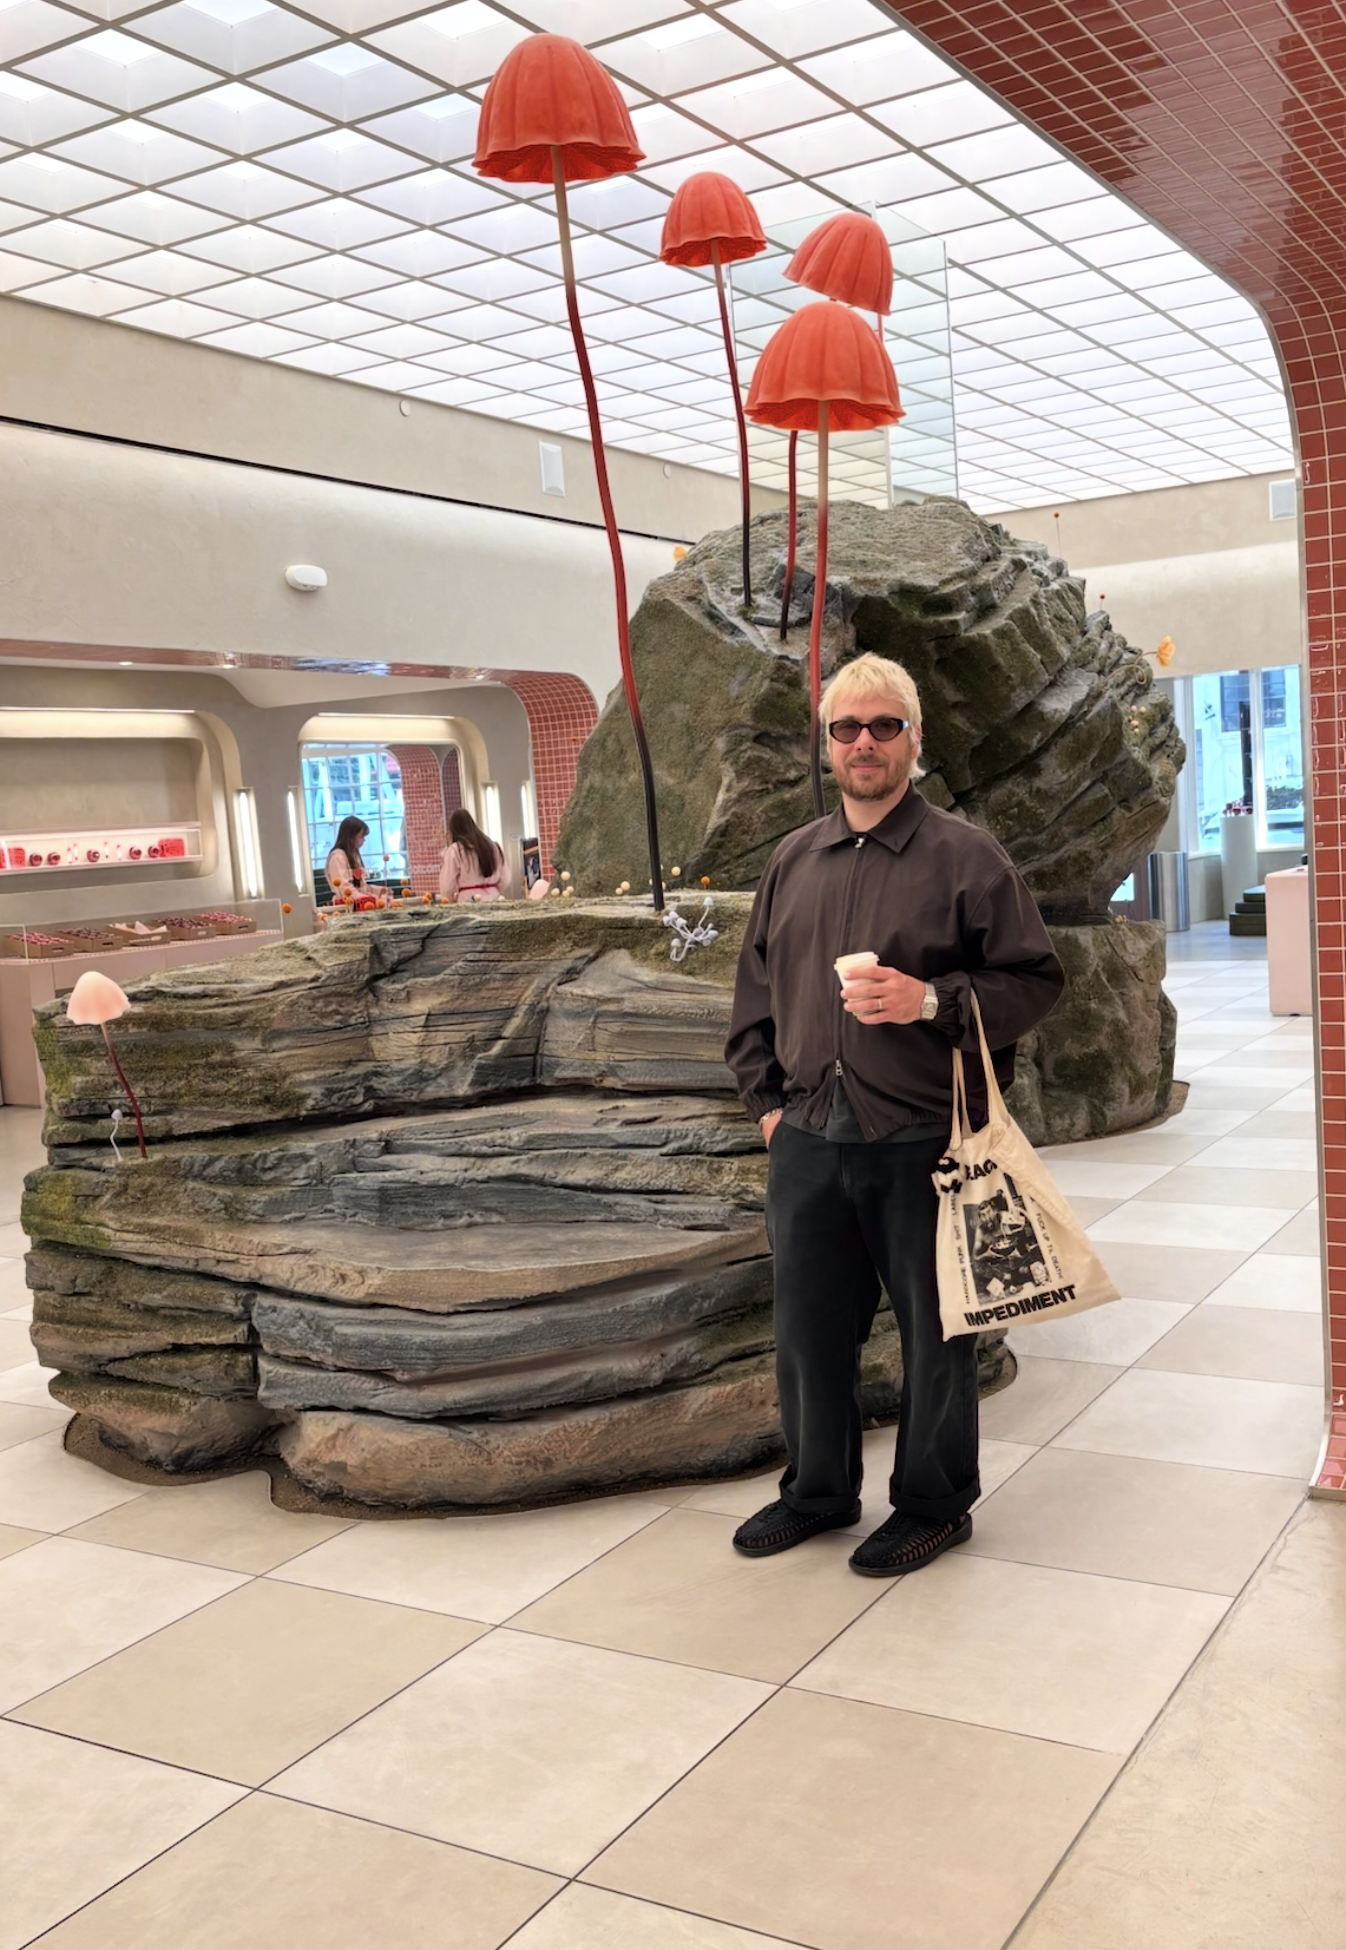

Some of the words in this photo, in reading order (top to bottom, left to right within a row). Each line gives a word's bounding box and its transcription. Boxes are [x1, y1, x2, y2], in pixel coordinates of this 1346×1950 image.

[953, 1224, 962, 1241] SHIT
[1036, 1213, 1047, 1231] FUCK
[1042, 1232, 1051, 1242] UP
[957, 1245, 965, 1264] PUNK
[963, 1284, 1076, 1327] IMPEDIMENT
